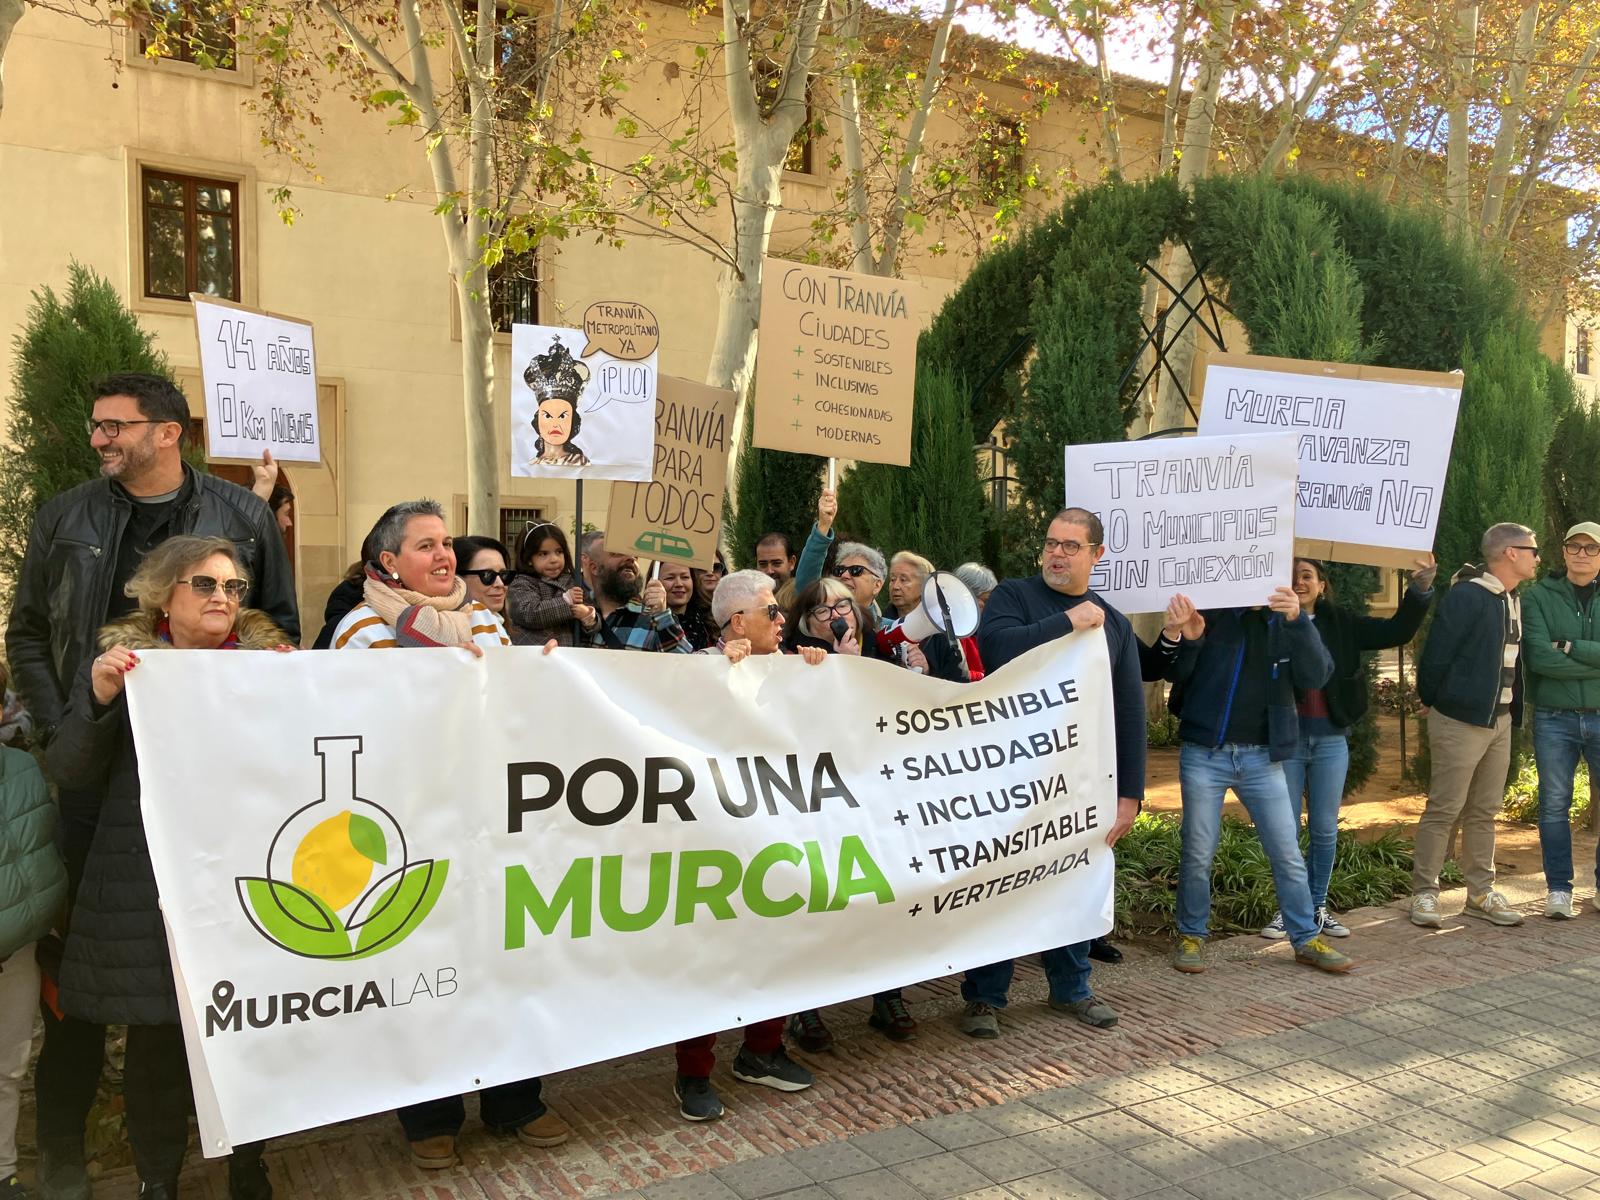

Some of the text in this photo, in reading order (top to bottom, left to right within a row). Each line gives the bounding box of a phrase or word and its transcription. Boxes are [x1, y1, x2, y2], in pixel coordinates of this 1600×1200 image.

[596, 305, 645, 320] TRANVÍA
[783, 268, 908, 319] CON TRANVÍA
[217, 319, 311, 375] 14 AÑOS
[618, 337, 636, 354] YA
[813, 349, 893, 375] SOSTENIBLES
[602, 366, 647, 398] ¡PIJO!
[815, 372, 879, 396] INCLUSIVAS
[655, 398, 724, 453] RANVÍA
[814, 400, 893, 422] COHESIONADAS
[1225, 388, 1345, 429] MURCIA
[816, 425, 881, 445] MODERNAS
[1298, 434, 1410, 466] AVANZA
[654, 443, 703, 487] PARA
[1094, 445, 1254, 499] TRANVÍA
[1296, 475, 1433, 529] RANVÍA NO
[1143, 506, 1278, 549] MUNICIPIOS
[1089, 545, 1274, 592] SIN CONEXIÓN
[895, 679, 1080, 736] SOSTENIBLE
[902, 723, 1079, 781] SALUDABLE
[507, 751, 861, 834] POR UNA
[916, 773, 1068, 827] INCLUSIVA
[929, 805, 1099, 875] TRANSITABLE
[504, 834, 896, 951] MURCIA
[932, 847, 1091, 915] VERTEBRADA
